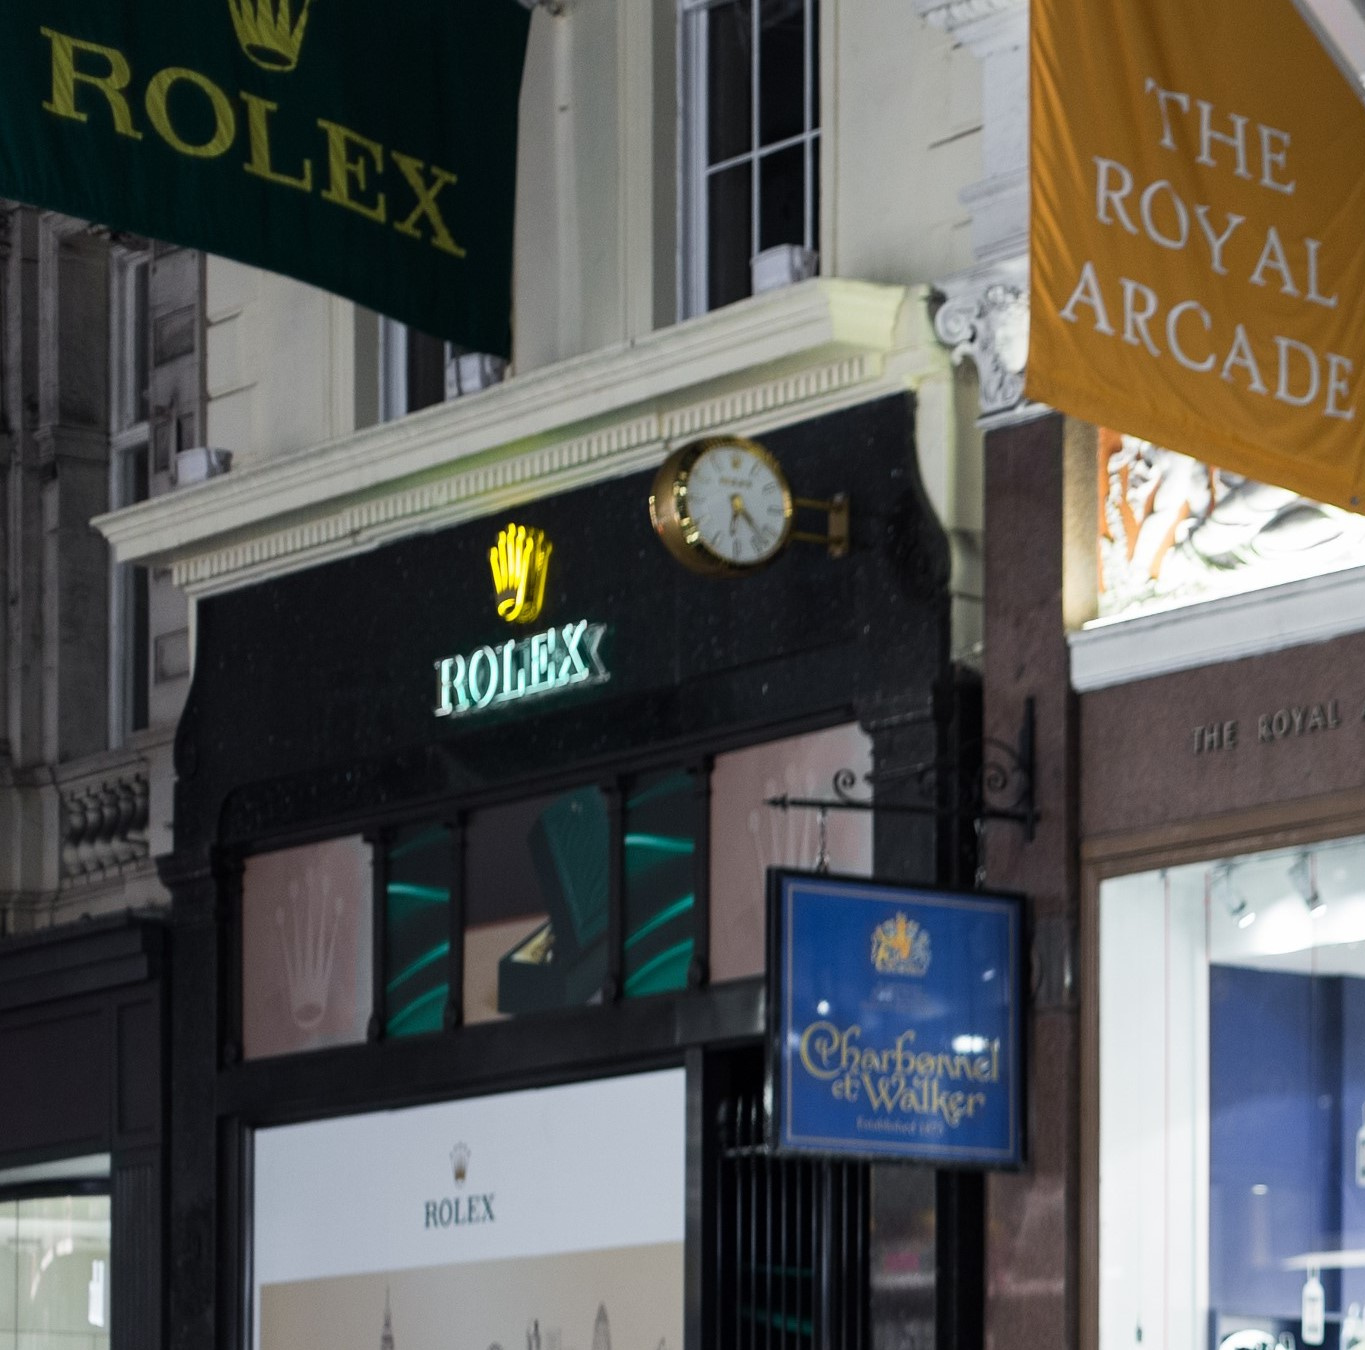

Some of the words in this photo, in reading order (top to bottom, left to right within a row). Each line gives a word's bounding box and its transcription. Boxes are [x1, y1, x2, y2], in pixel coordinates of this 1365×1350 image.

[40, 26, 466, 258] ROLEX
[1145, 77, 1295, 194] THE
[1093, 155, 1339, 308] ROYAL
[1060, 260, 1356, 422] ARCADE
[434, 619, 609, 718] ROLEX
[1191, 720, 1239, 755] THE
[1257, 700, 1341, 744] ROYAL
[800, 1020, 1000, 1082] Charbonnel
[862, 1072, 986, 1128] Walker
[424, 1193, 495, 1229] ROLEX
